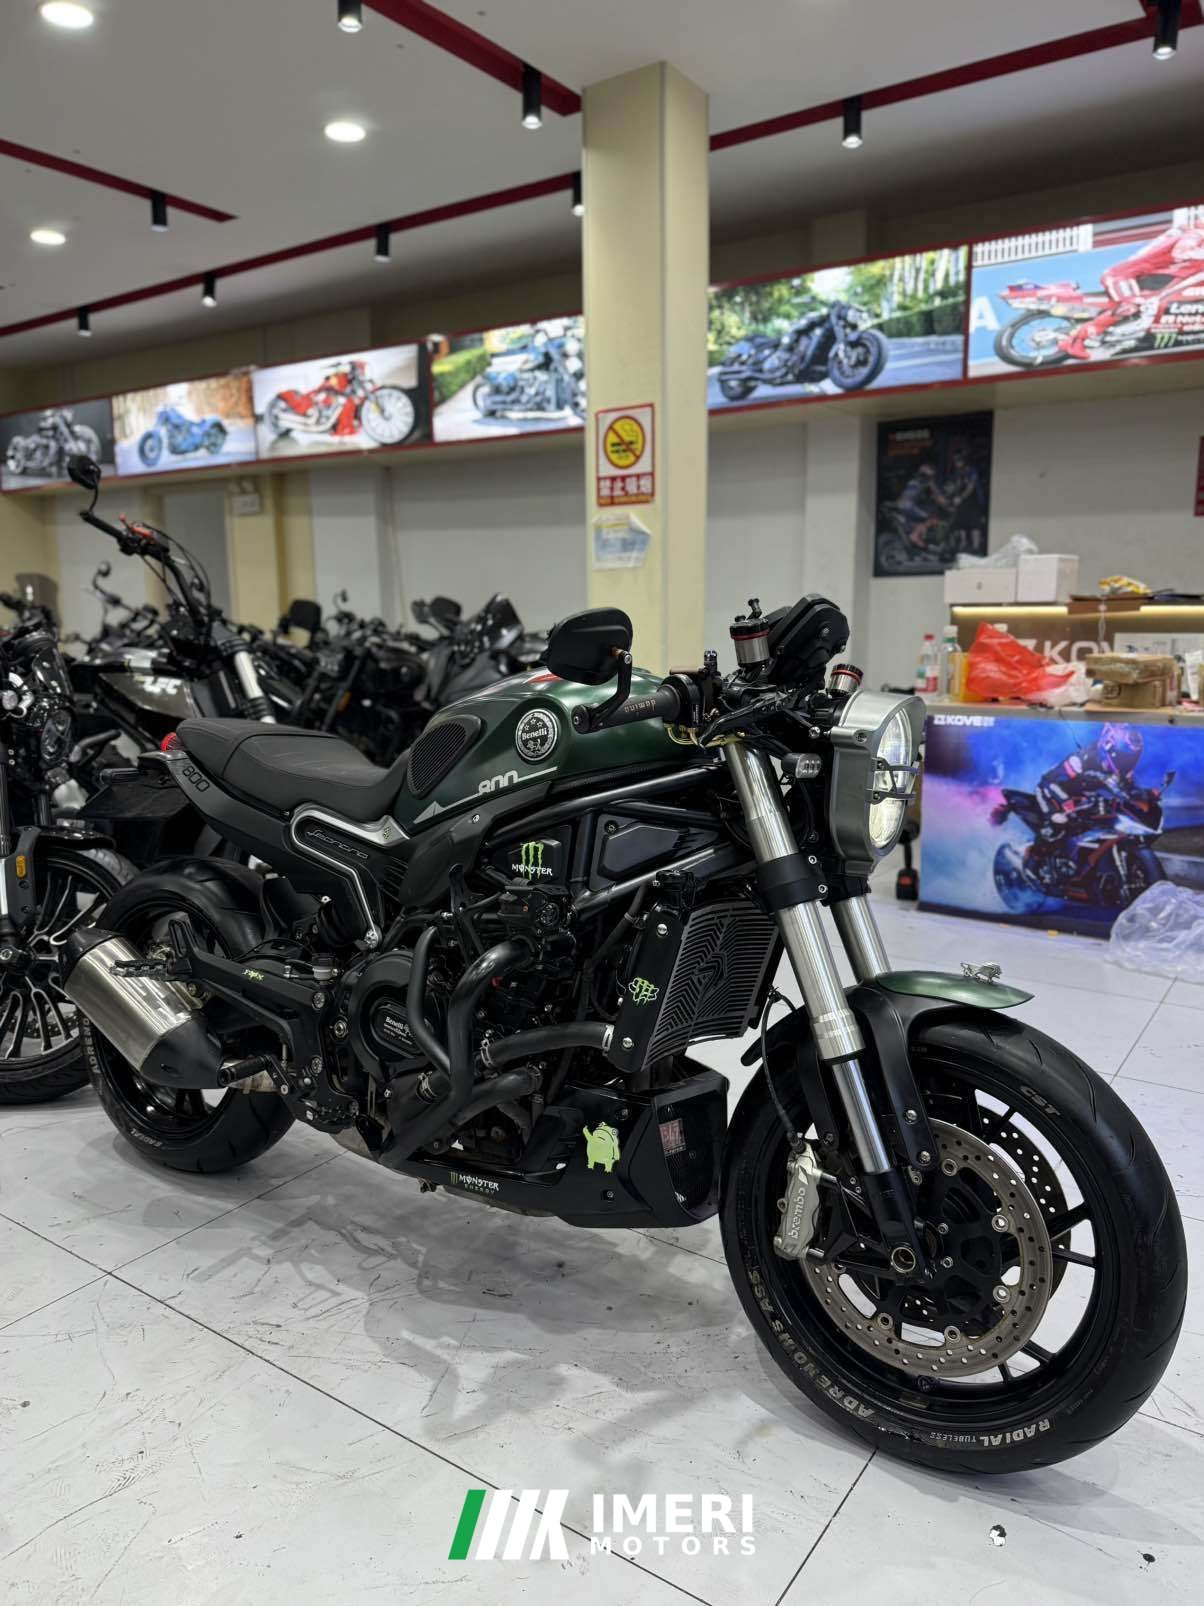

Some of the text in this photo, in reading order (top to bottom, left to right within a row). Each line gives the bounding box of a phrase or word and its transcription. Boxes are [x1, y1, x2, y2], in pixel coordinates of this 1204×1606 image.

[521, 727, 548, 741] Benelli
[183, 765, 210, 792] 800
[511, 863, 553, 877] MONSTER
[1020, 1085, 1061, 1116] CST
[459, 1174, 500, 1192] MONSTER
[788, 1187, 806, 1240] brembo
[793, 1350, 876, 1420] ADRENO
[929, 1418, 1051, 1447] RADIAL TUBELESS
